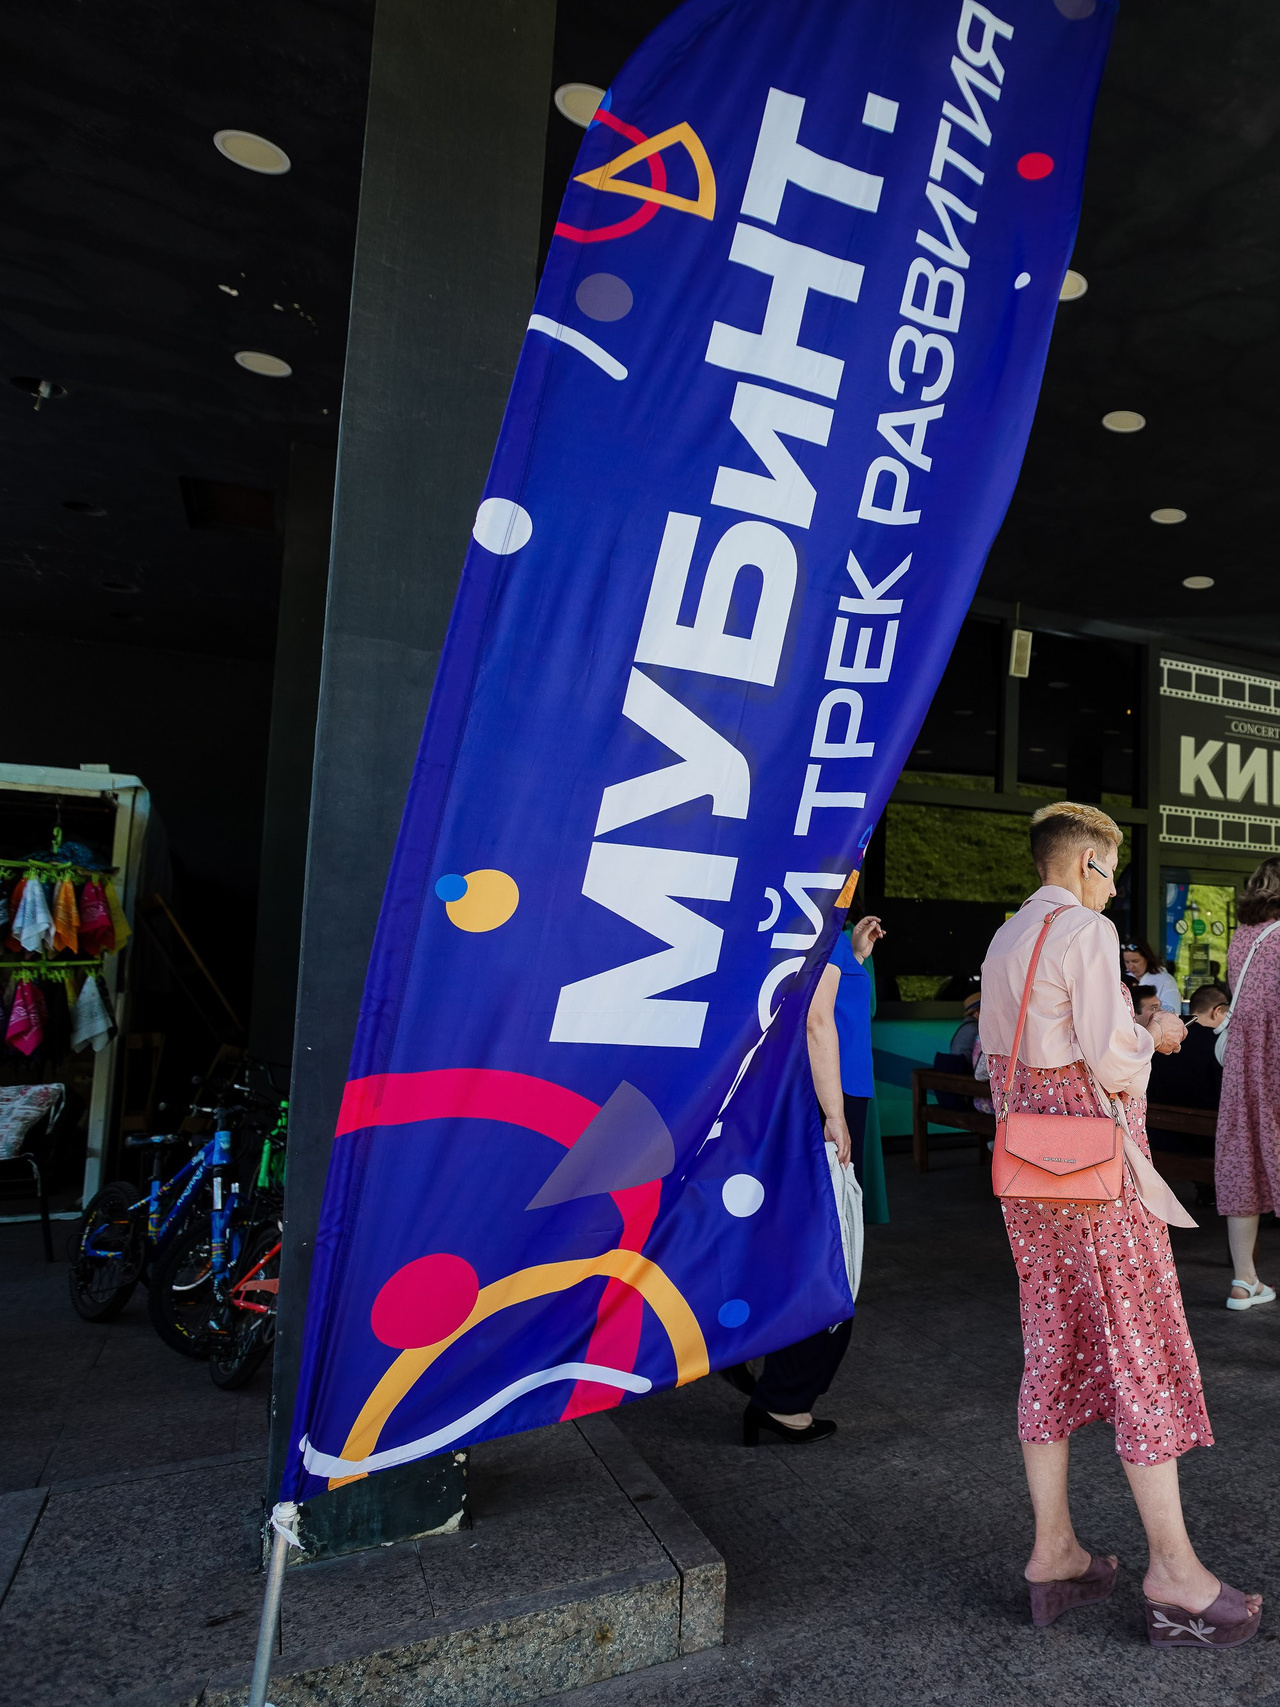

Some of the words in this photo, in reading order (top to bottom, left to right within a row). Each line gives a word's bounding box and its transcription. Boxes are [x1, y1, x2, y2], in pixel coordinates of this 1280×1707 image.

[793, 549, 912, 836] ТРЕК
[857, 0, 1015, 525] РАЗВИТИЯ
[1231, 720, 1280, 739] CONCERT
